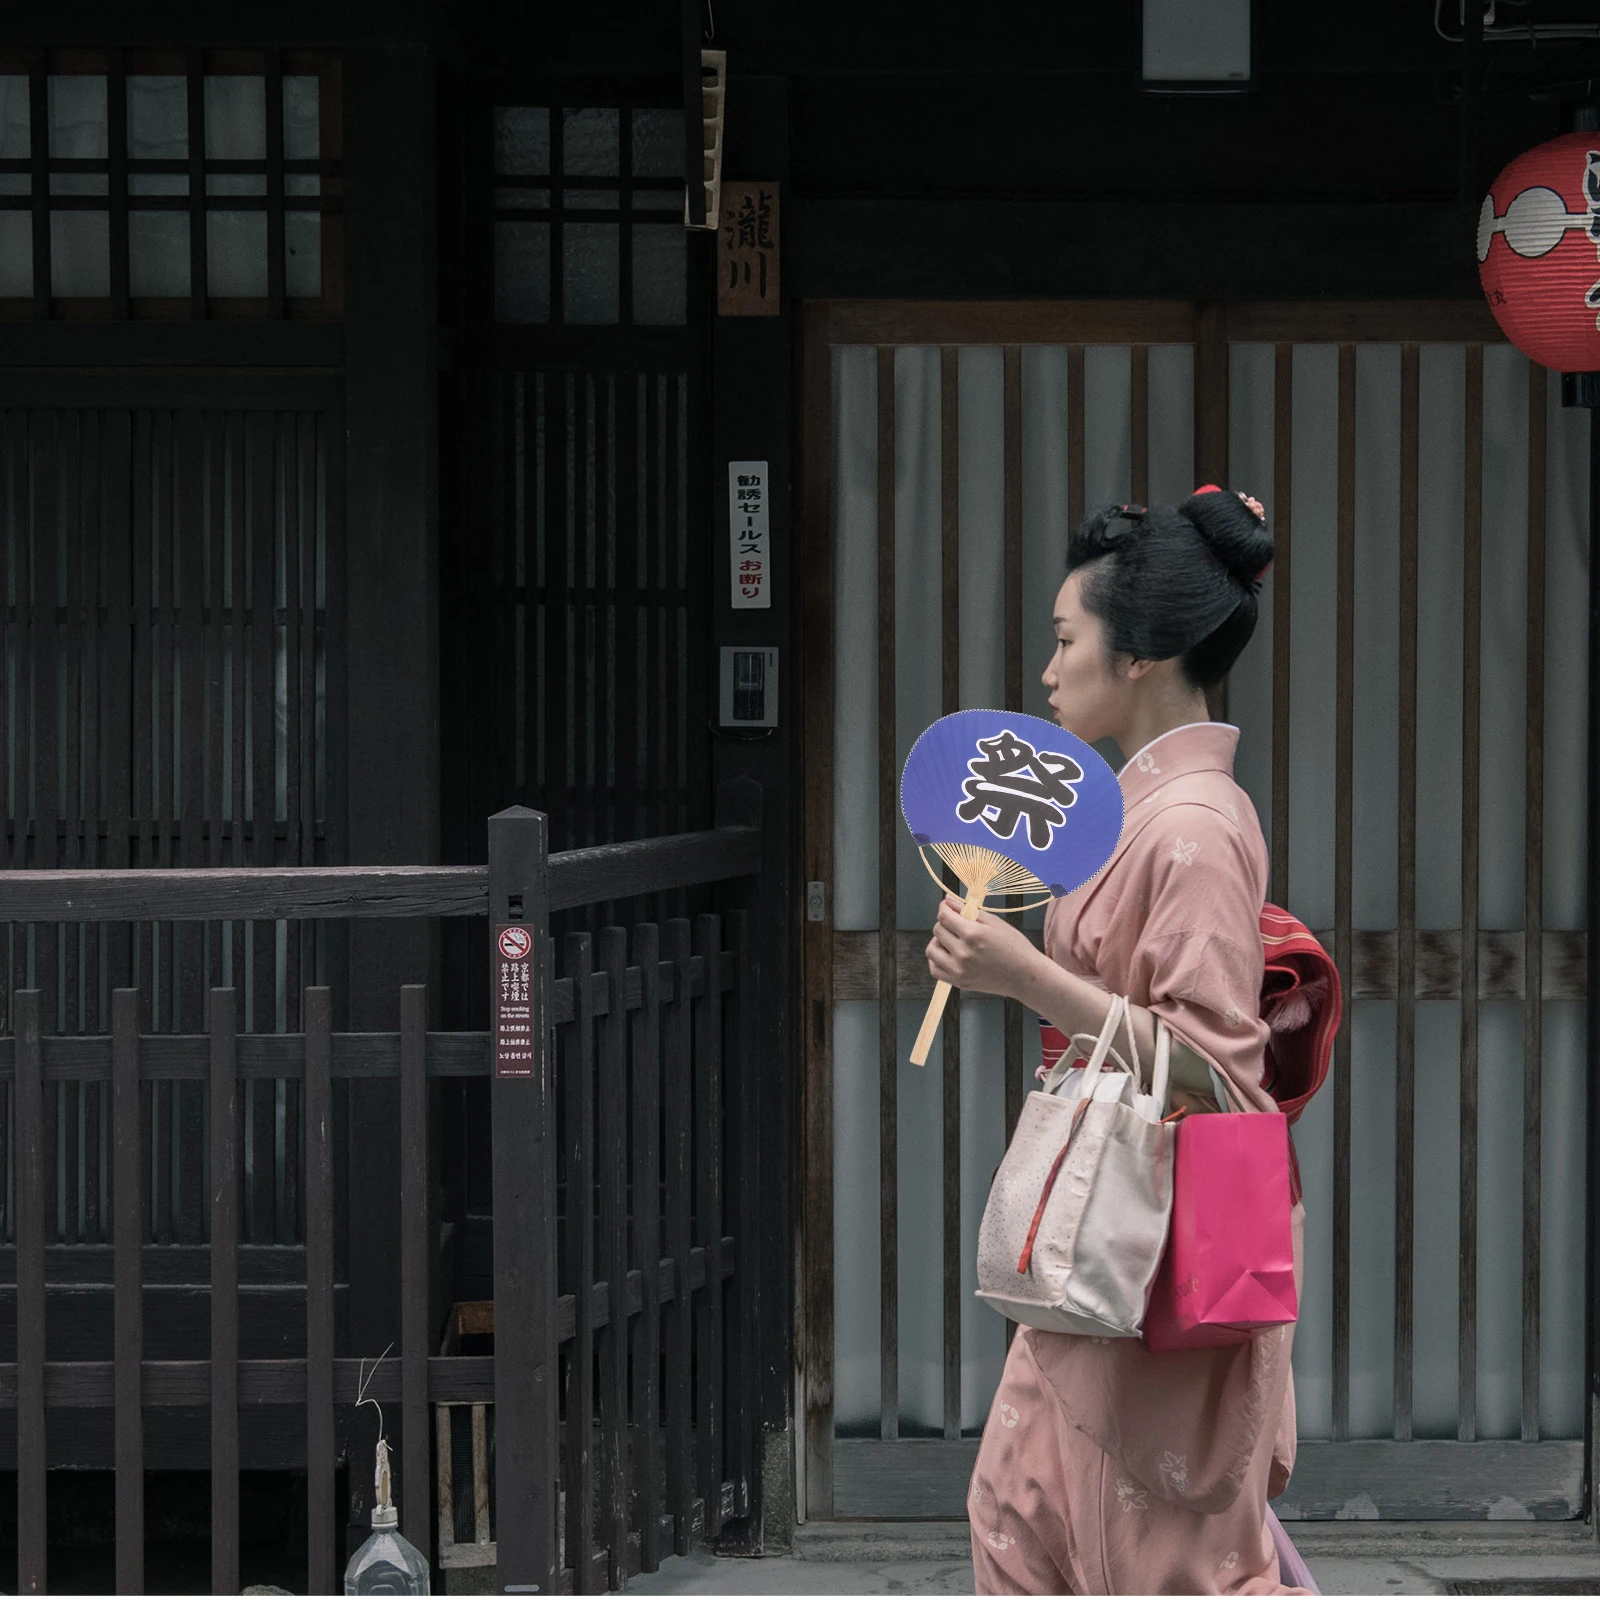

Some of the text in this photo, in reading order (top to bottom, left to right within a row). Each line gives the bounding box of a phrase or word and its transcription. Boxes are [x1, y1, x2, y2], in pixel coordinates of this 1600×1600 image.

[736, 475, 763, 599] 勧誘セールスお断り
[955, 729, 1084, 851] 祭
[501, 962, 510, 1002] 禁止です
